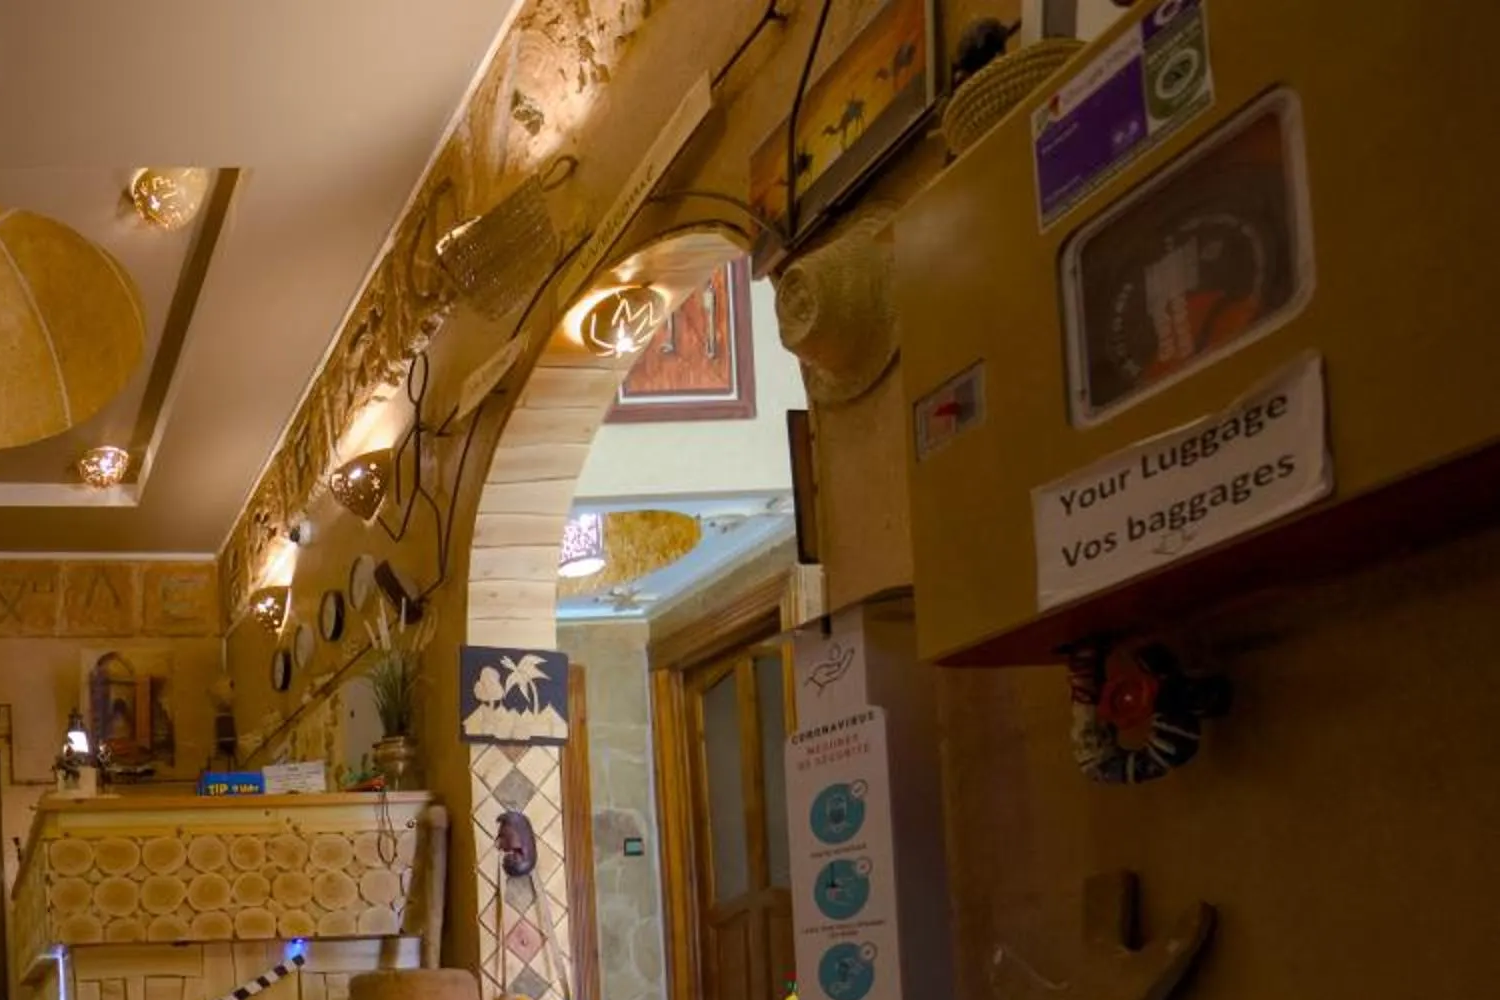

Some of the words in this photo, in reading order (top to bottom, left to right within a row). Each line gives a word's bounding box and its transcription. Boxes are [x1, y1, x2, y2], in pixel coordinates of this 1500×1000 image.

[1059, 468, 1131, 517] Your
[1140, 393, 1288, 481] Luggage
[1060, 531, 1119, 568] Vos
[1126, 453, 1296, 542] baggages
[791, 710, 875, 746] CORONAVIRUS
